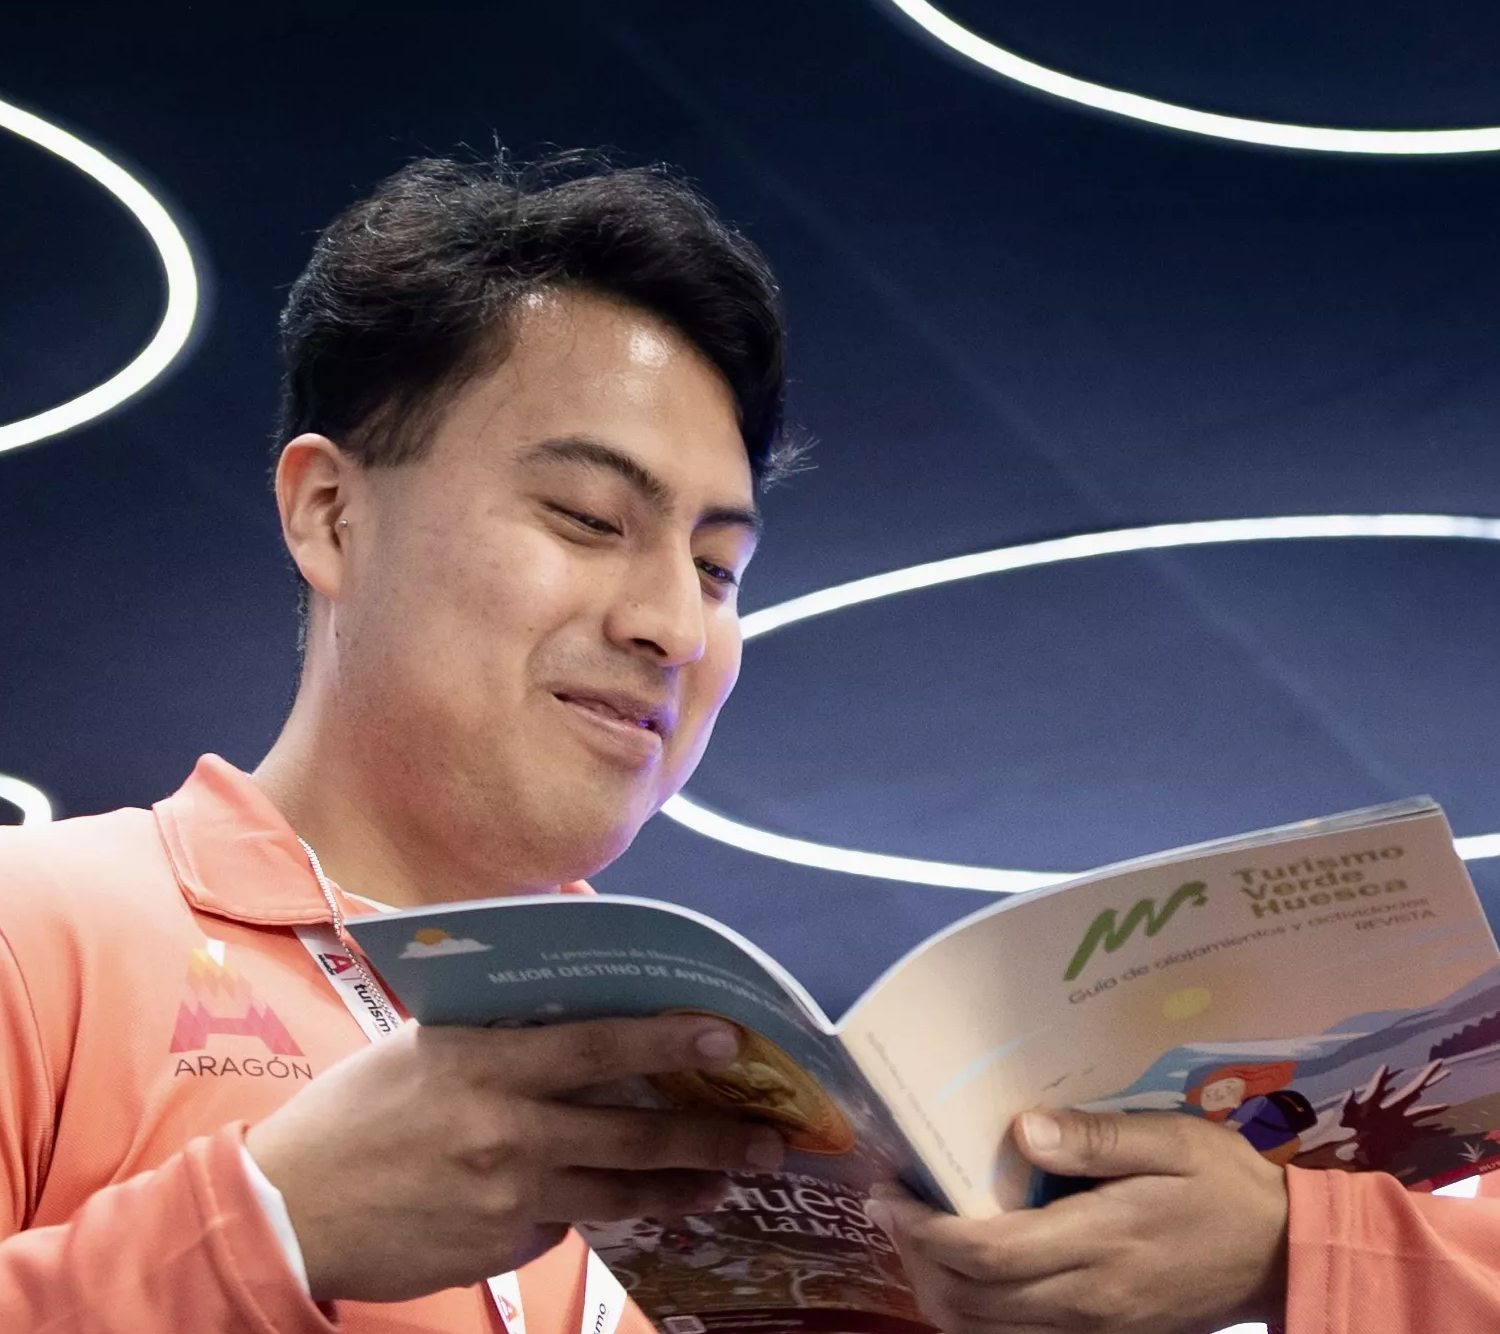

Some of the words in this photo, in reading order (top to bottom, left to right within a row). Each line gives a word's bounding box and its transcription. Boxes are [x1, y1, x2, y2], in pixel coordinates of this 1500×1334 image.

[1233, 845, 1404, 886] Turismo
[1241, 869, 1366, 901] Verde
[1250, 877, 1409, 919] Huesca
[353, 982, 393, 1033] turism
[174, 1055, 314, 1081] ARAGÓN
[713, 1185, 875, 1229] Hues
